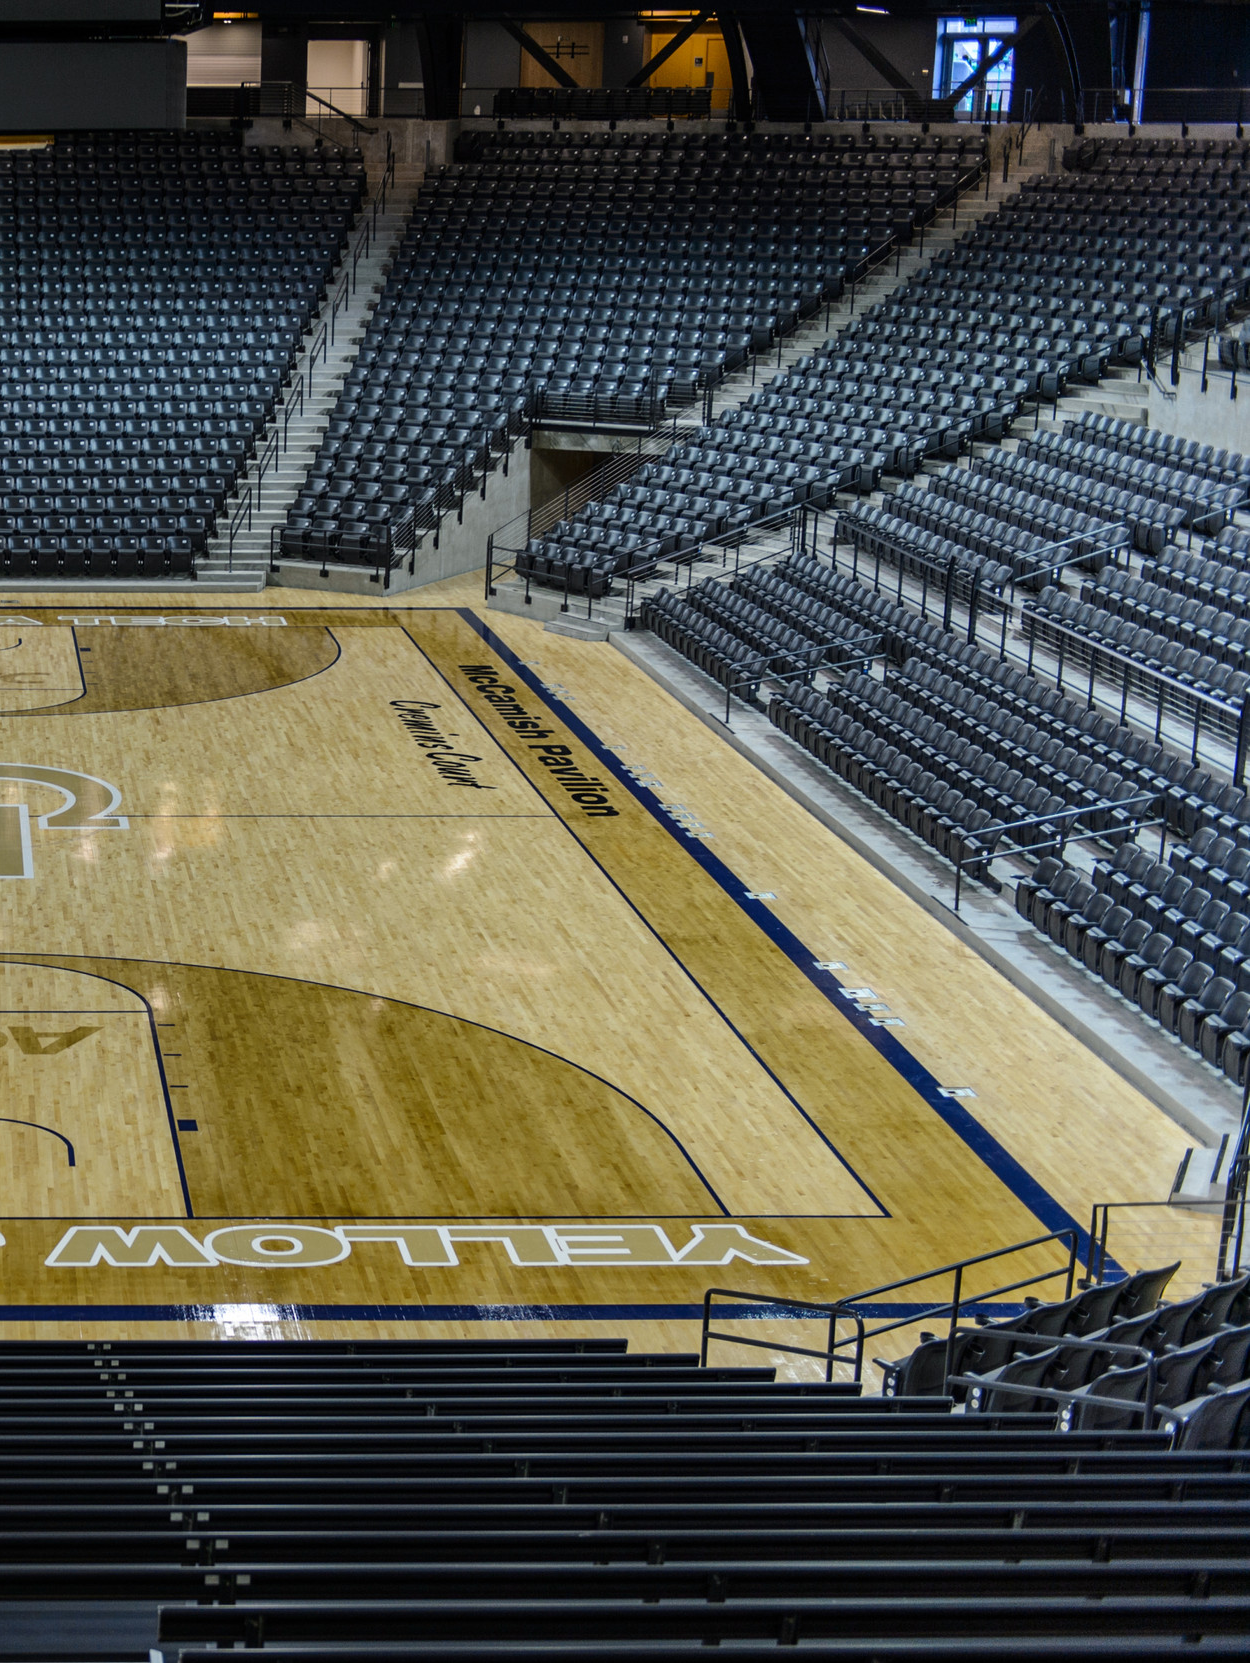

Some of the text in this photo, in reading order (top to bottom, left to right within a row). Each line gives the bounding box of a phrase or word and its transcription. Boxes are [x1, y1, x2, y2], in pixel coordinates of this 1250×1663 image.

[57, 616, 288, 626] TECH
[389, 700, 497, 789] Cremins Court
[458, 665, 620, 816] McCamish Pavilion
[44, 1224, 810, 1267] YELLOW
